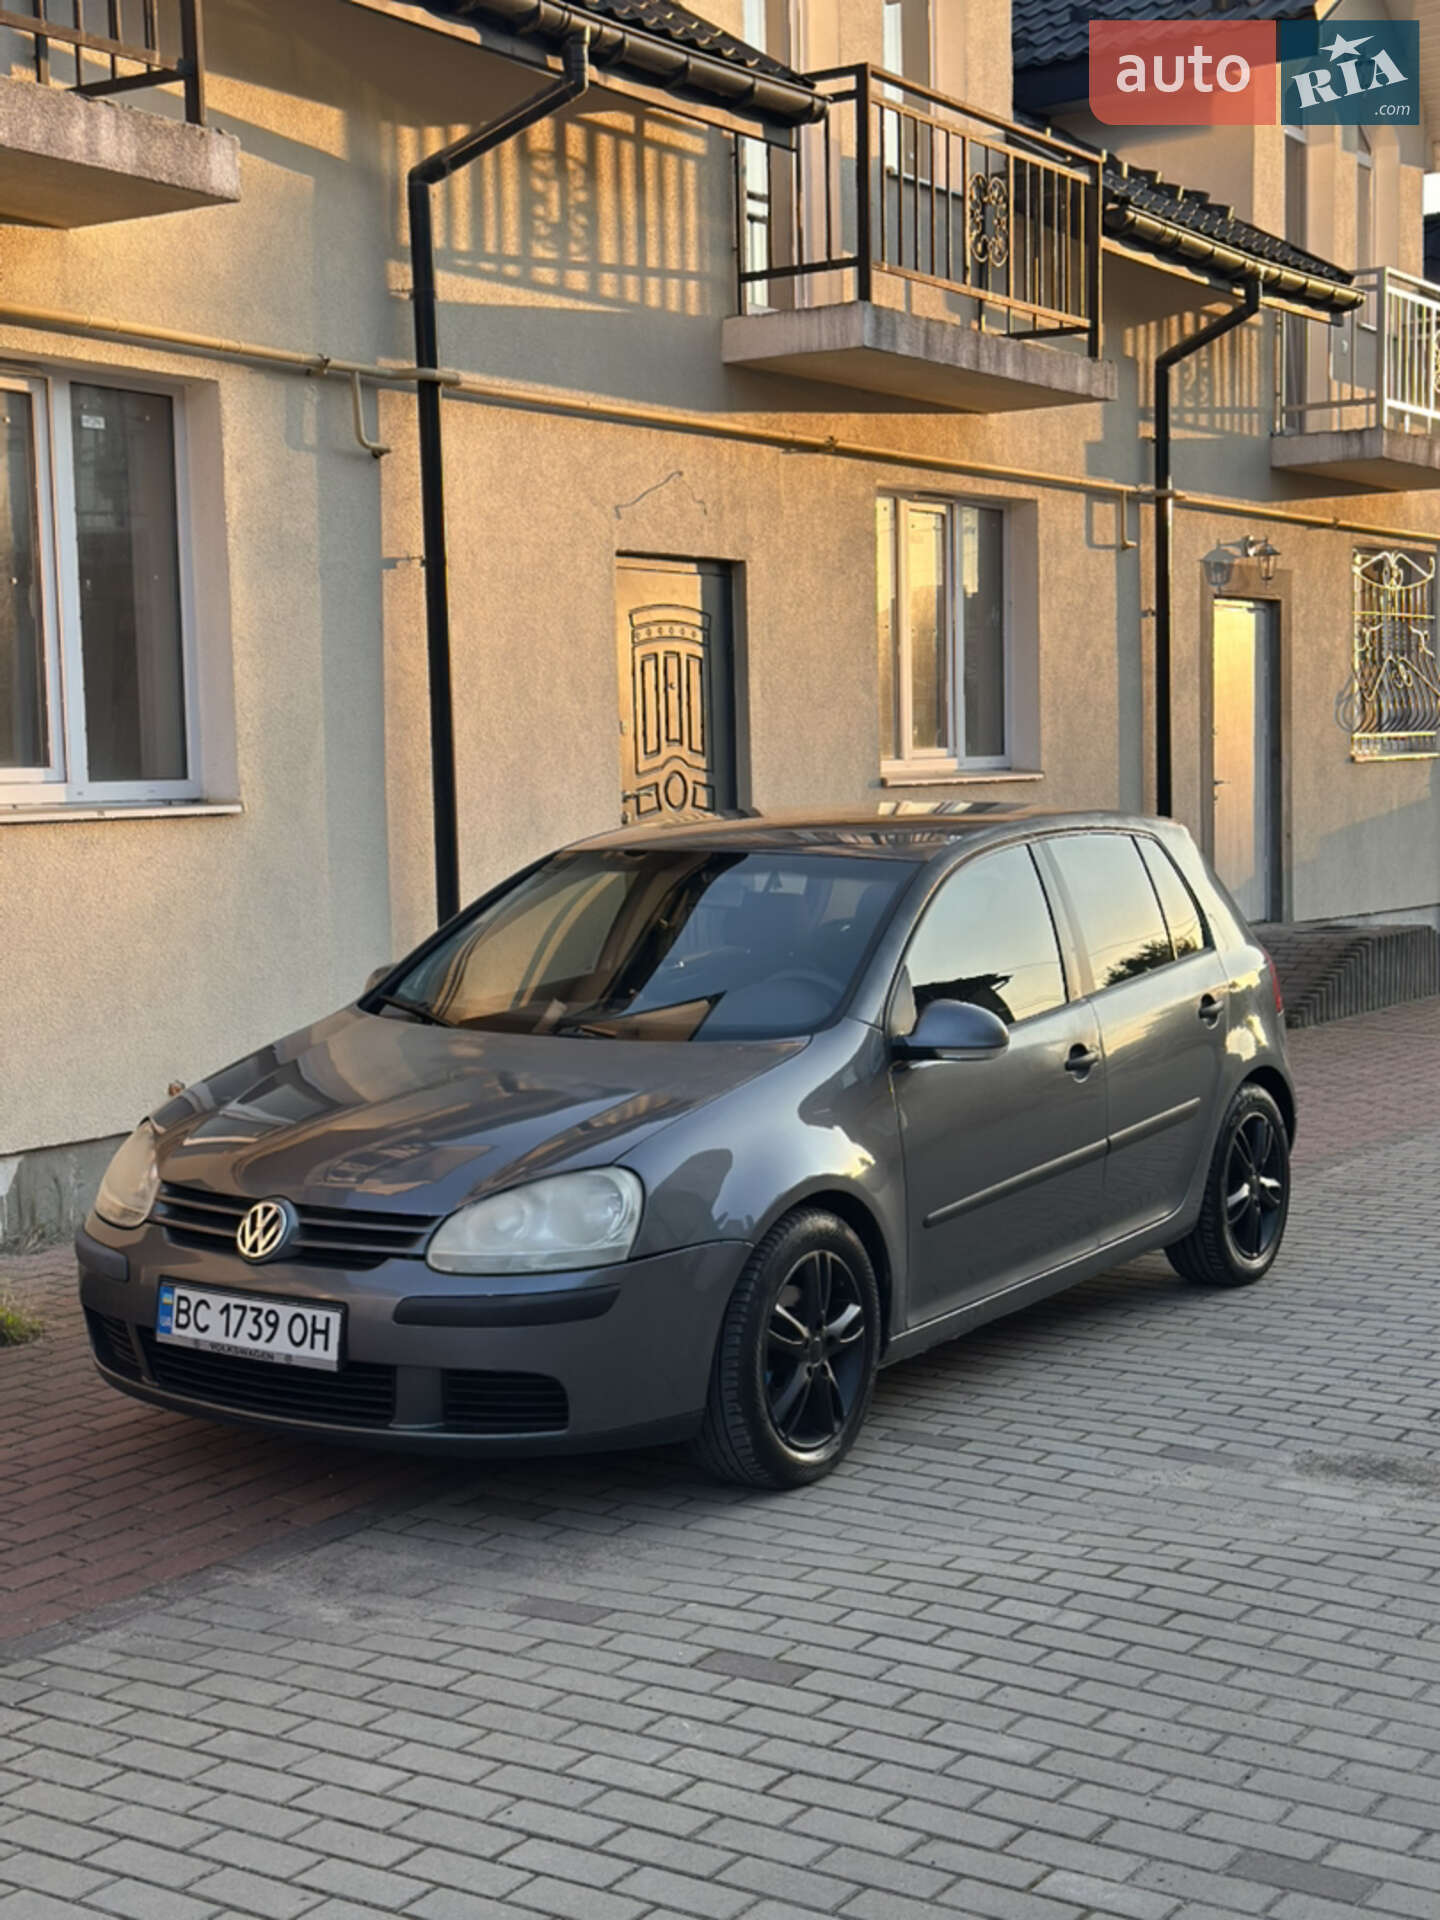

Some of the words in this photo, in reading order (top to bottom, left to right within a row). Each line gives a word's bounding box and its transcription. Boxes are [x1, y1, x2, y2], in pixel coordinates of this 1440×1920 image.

[174, 1295, 211, 1334] BC
[219, 1302, 279, 1344] 1739
[287, 1312, 330, 1352] OH
